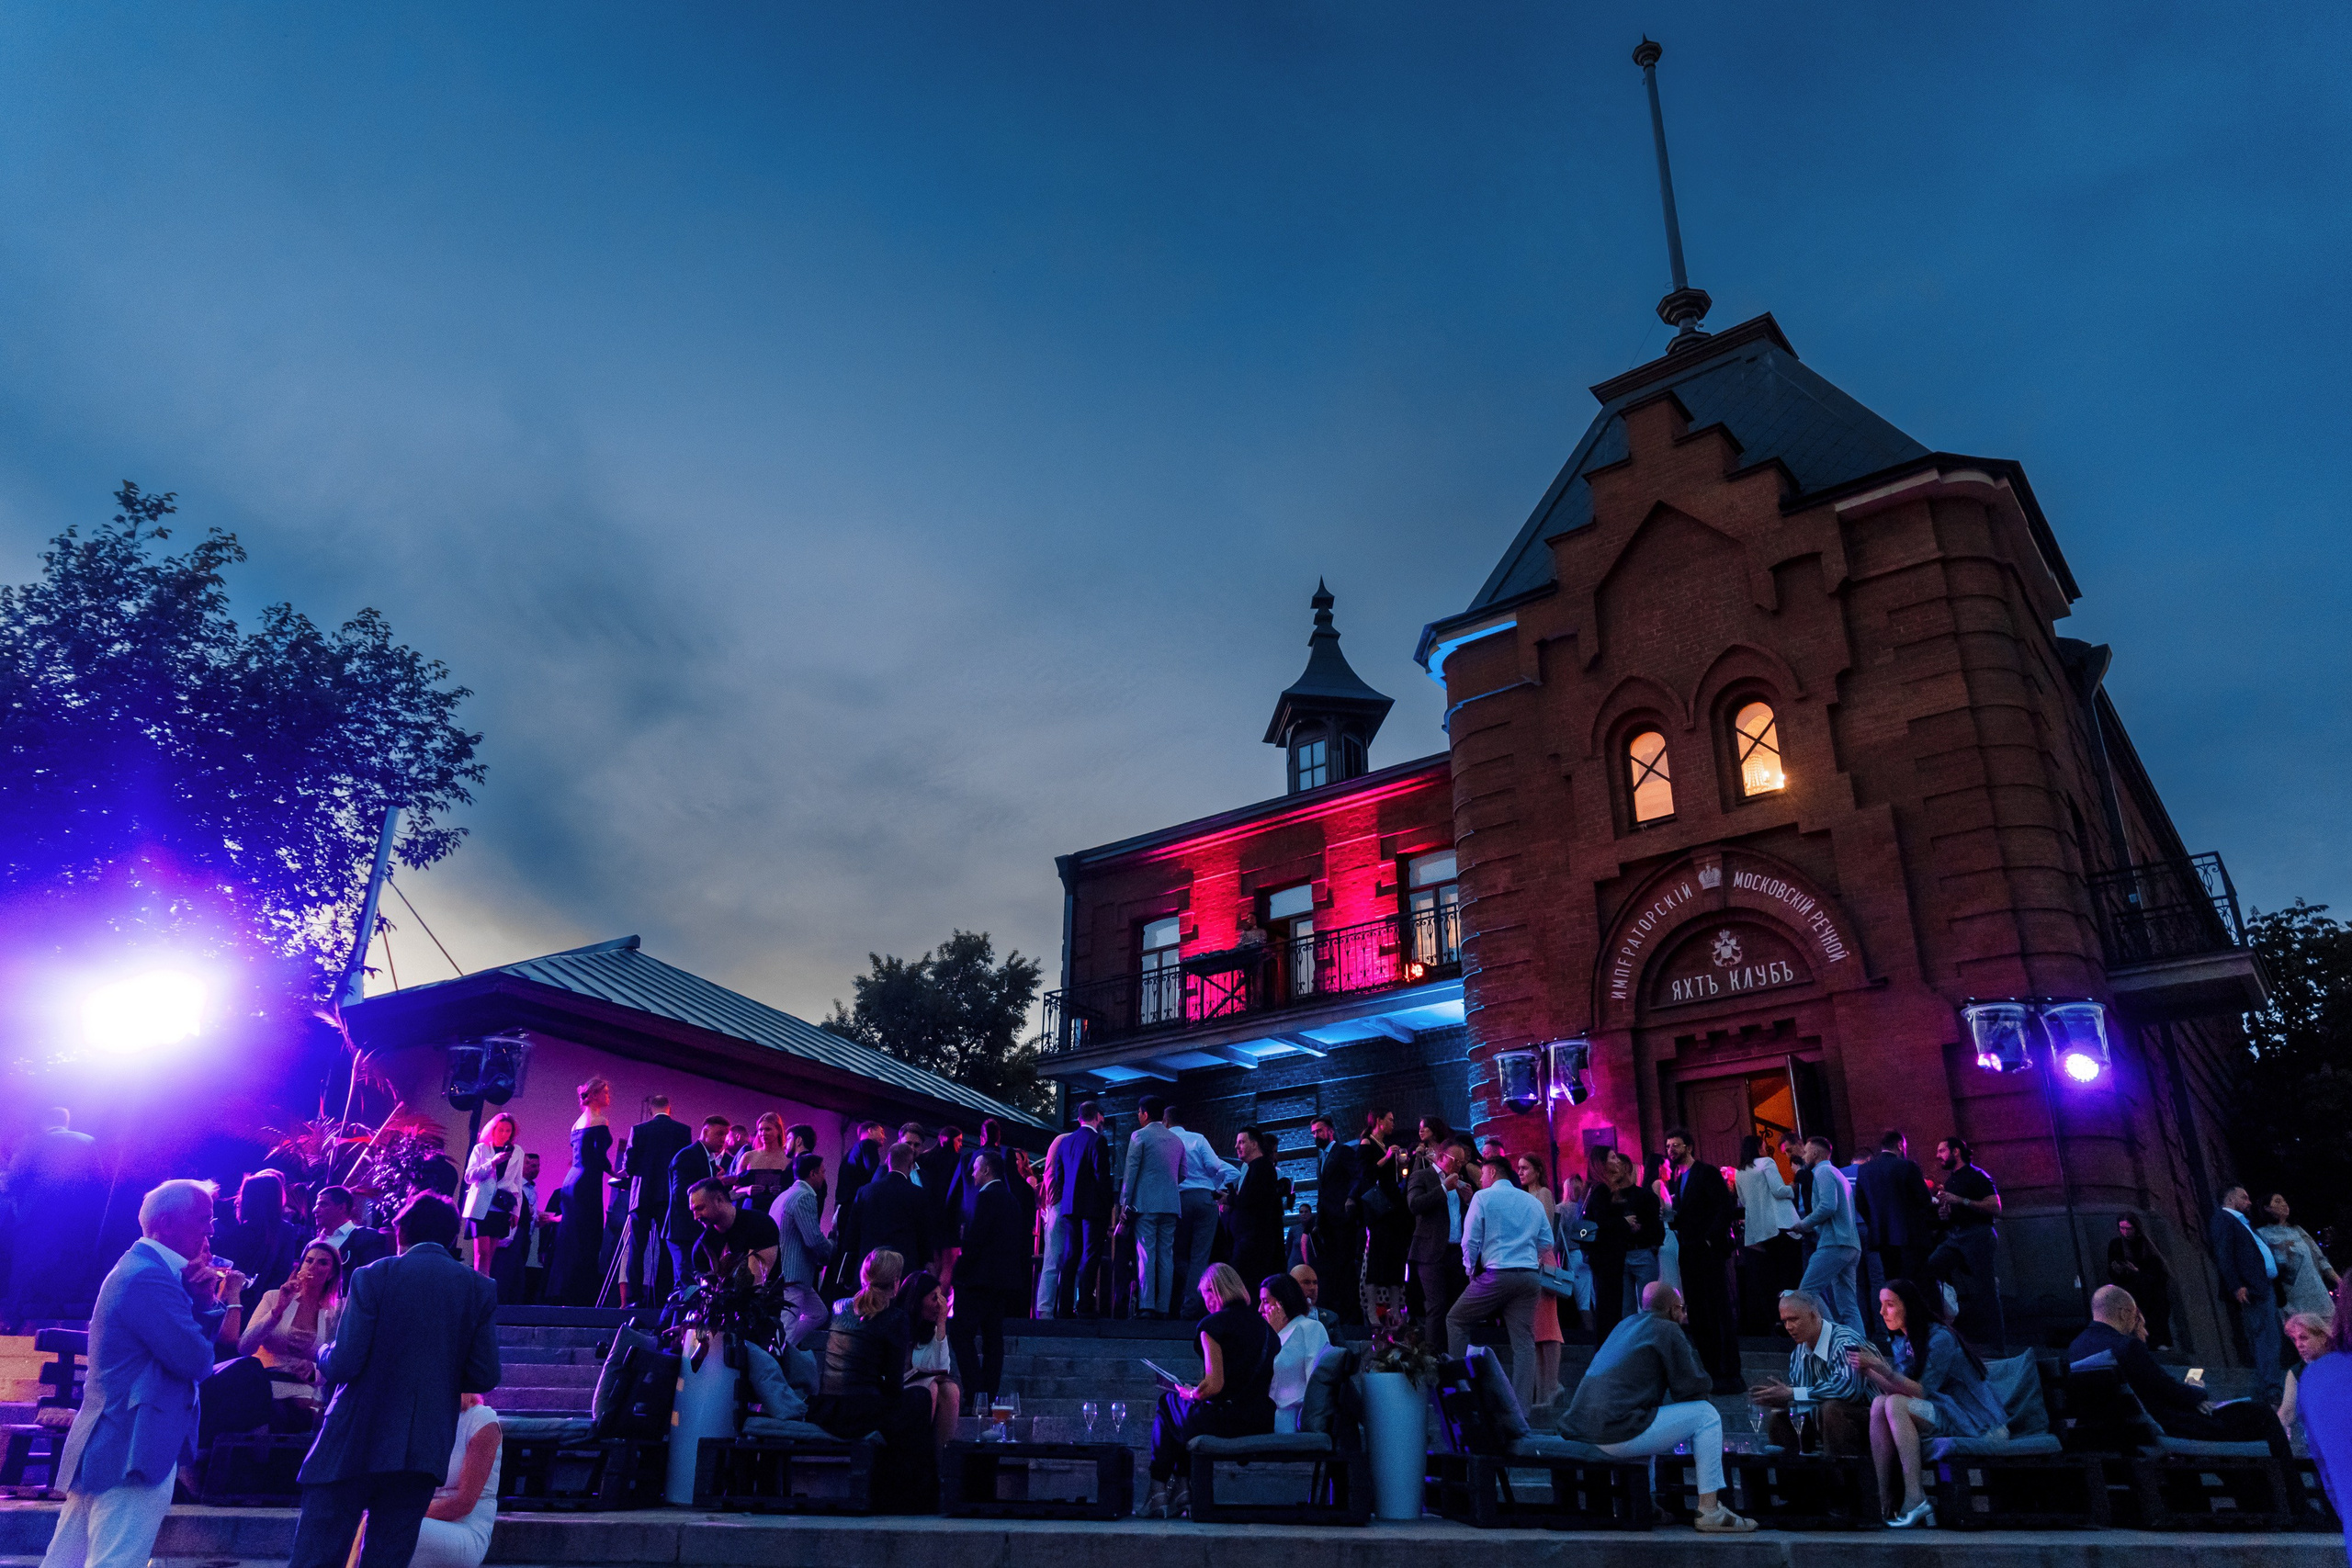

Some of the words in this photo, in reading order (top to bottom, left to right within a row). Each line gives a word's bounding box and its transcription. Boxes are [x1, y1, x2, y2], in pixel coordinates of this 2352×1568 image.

[1611, 882, 1692, 999] ИМПЕРАТОРСКІЙ
[1733, 871, 1815, 916] МОСКОВСКІЙ
[1807, 909, 1850, 963] РЕЧНОЙ
[1671, 973, 1719, 1001] ЯХТЪ
[1729, 961, 1794, 991] КЛУБЪ
